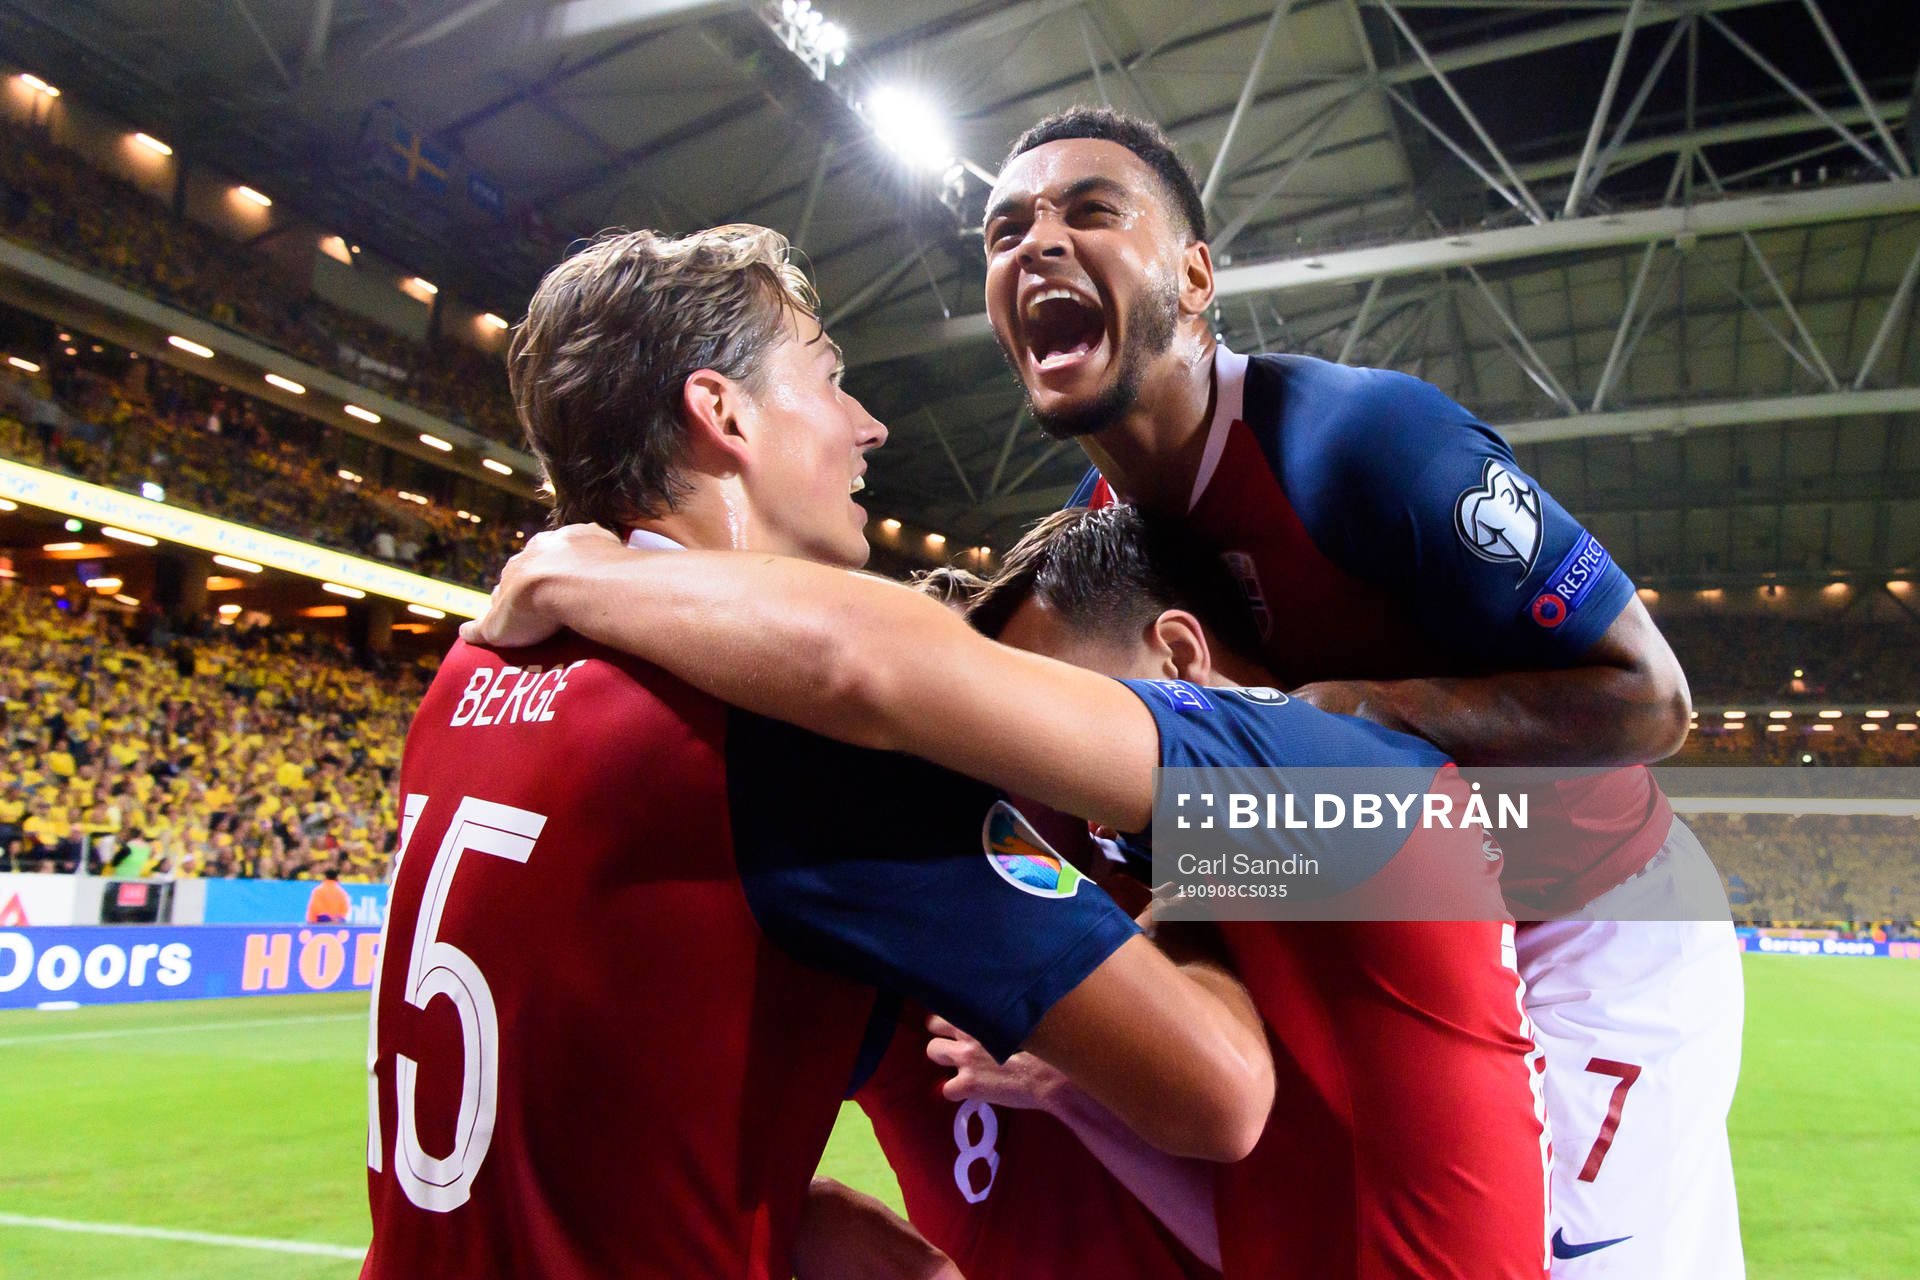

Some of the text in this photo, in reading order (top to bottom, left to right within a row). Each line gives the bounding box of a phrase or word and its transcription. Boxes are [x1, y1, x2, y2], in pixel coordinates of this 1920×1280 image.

[450, 659, 588, 727] BERGE
[1160, 680, 1203, 710] ECT
[368, 793, 548, 1213] 15
[954, 1099, 1000, 1204] 8
[1577, 1057, 1642, 1183] 7
